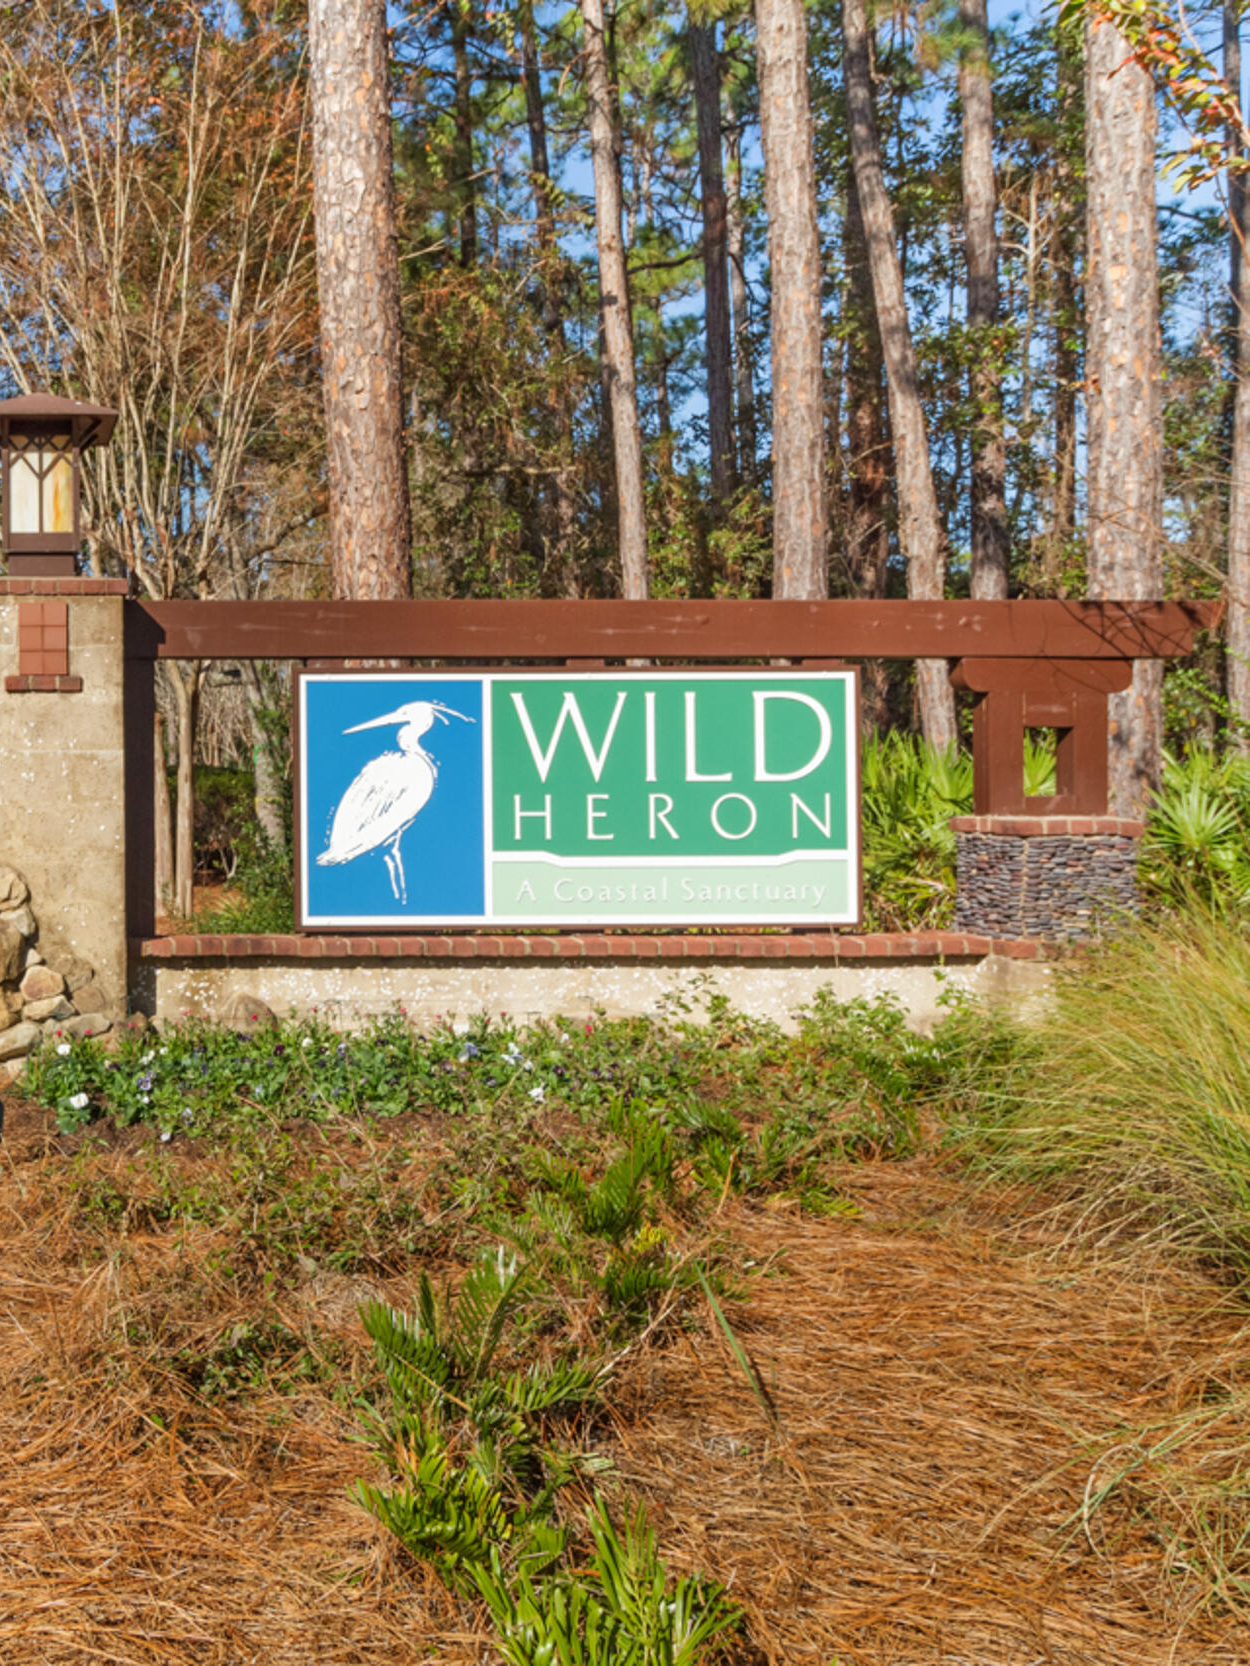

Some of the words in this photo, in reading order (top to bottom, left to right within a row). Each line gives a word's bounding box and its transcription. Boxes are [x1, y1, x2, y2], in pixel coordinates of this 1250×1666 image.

[510, 691, 833, 783] WILD
[513, 792, 832, 841] HERON
[518, 879, 537, 902] A
[554, 877, 668, 903] Coastal
[681, 878, 827, 907] Sanctuary
